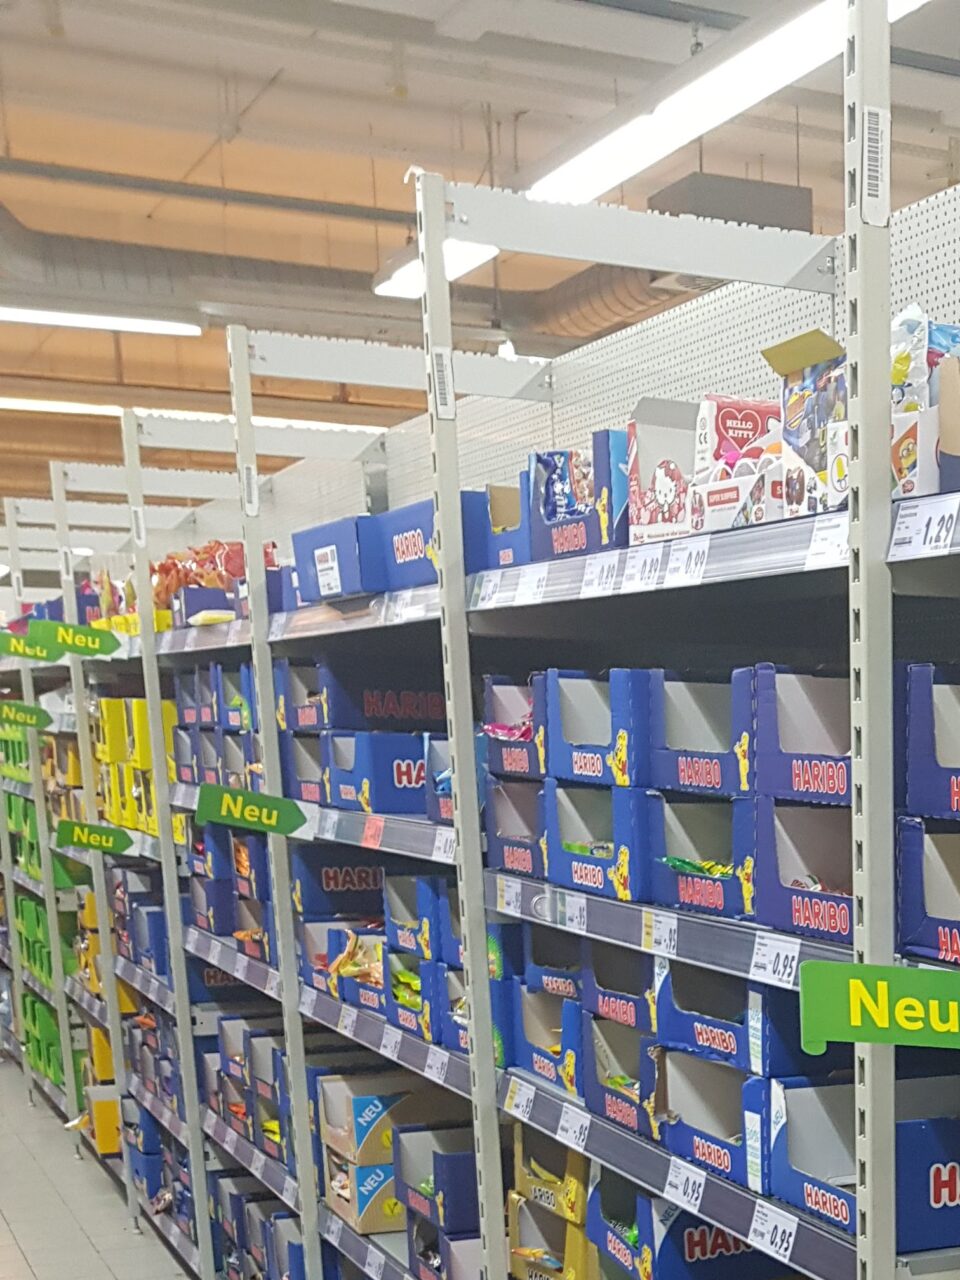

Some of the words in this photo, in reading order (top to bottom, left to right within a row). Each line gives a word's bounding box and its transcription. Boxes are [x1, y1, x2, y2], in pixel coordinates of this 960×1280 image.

[726, 418, 753, 430] HELLO
[728, 429, 755, 439] KITTY
[923, 513, 954, 547] 1.29
[392, 527, 426, 564] HARIBO
[56, 626, 100, 649] Neu
[2, 704, 37, 725] Neu
[363, 690, 447, 719] HARIB
[572, 751, 603, 778] HARIBO
[678, 756, 722, 788] HARIBO
[791, 759, 848, 796] HARIBO
[219, 793, 279, 827] Neu
[72, 826, 114, 848] Neu
[323, 867, 385, 892] HARI
[572, 861, 605, 890] HARIBO
[678, 877, 725, 911] HARIBO
[791, 895, 850, 935] HARIBO
[772, 953, 797, 979] 0.95
[597, 995, 636, 1028] HARIBO
[849, 978, 960, 1033] Neu
[694, 1022, 737, 1055] HARIBO
[357, 1100, 383, 1127] NEU
[693, 1135, 732, 1174] HARIBO
[358, 1168, 385, 1195] NEU
[683, 1177, 702, 1202] 0.95
[803, 1182, 851, 1225] HARIBO
[769, 1223, 792, 1252] 0.95
